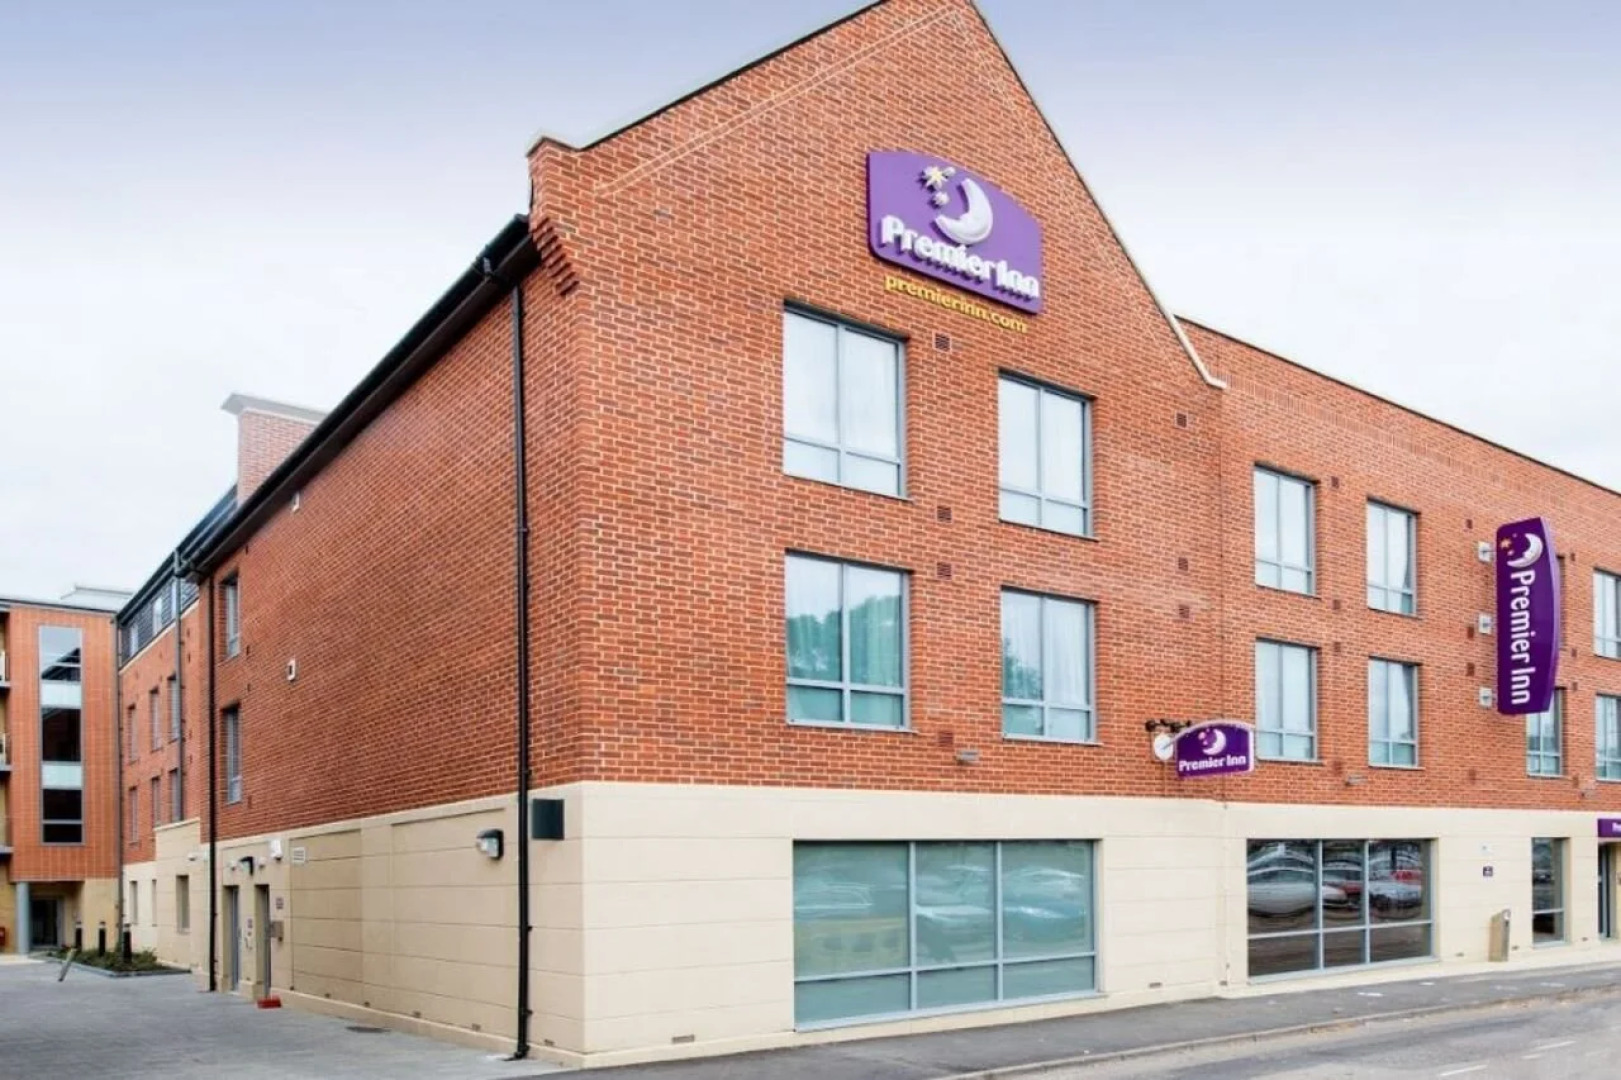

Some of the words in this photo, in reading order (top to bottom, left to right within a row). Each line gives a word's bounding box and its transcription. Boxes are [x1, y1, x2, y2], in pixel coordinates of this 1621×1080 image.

[881, 215, 996, 280] Premier
[996, 260, 1040, 298] Inn
[885, 275, 1028, 333] premierinn.com
[1510, 569, 1536, 663] Premier
[1511, 667, 1536, 705] Inn
[1178, 757, 1224, 772] Premier
[1226, 755, 1246, 767] Inn
